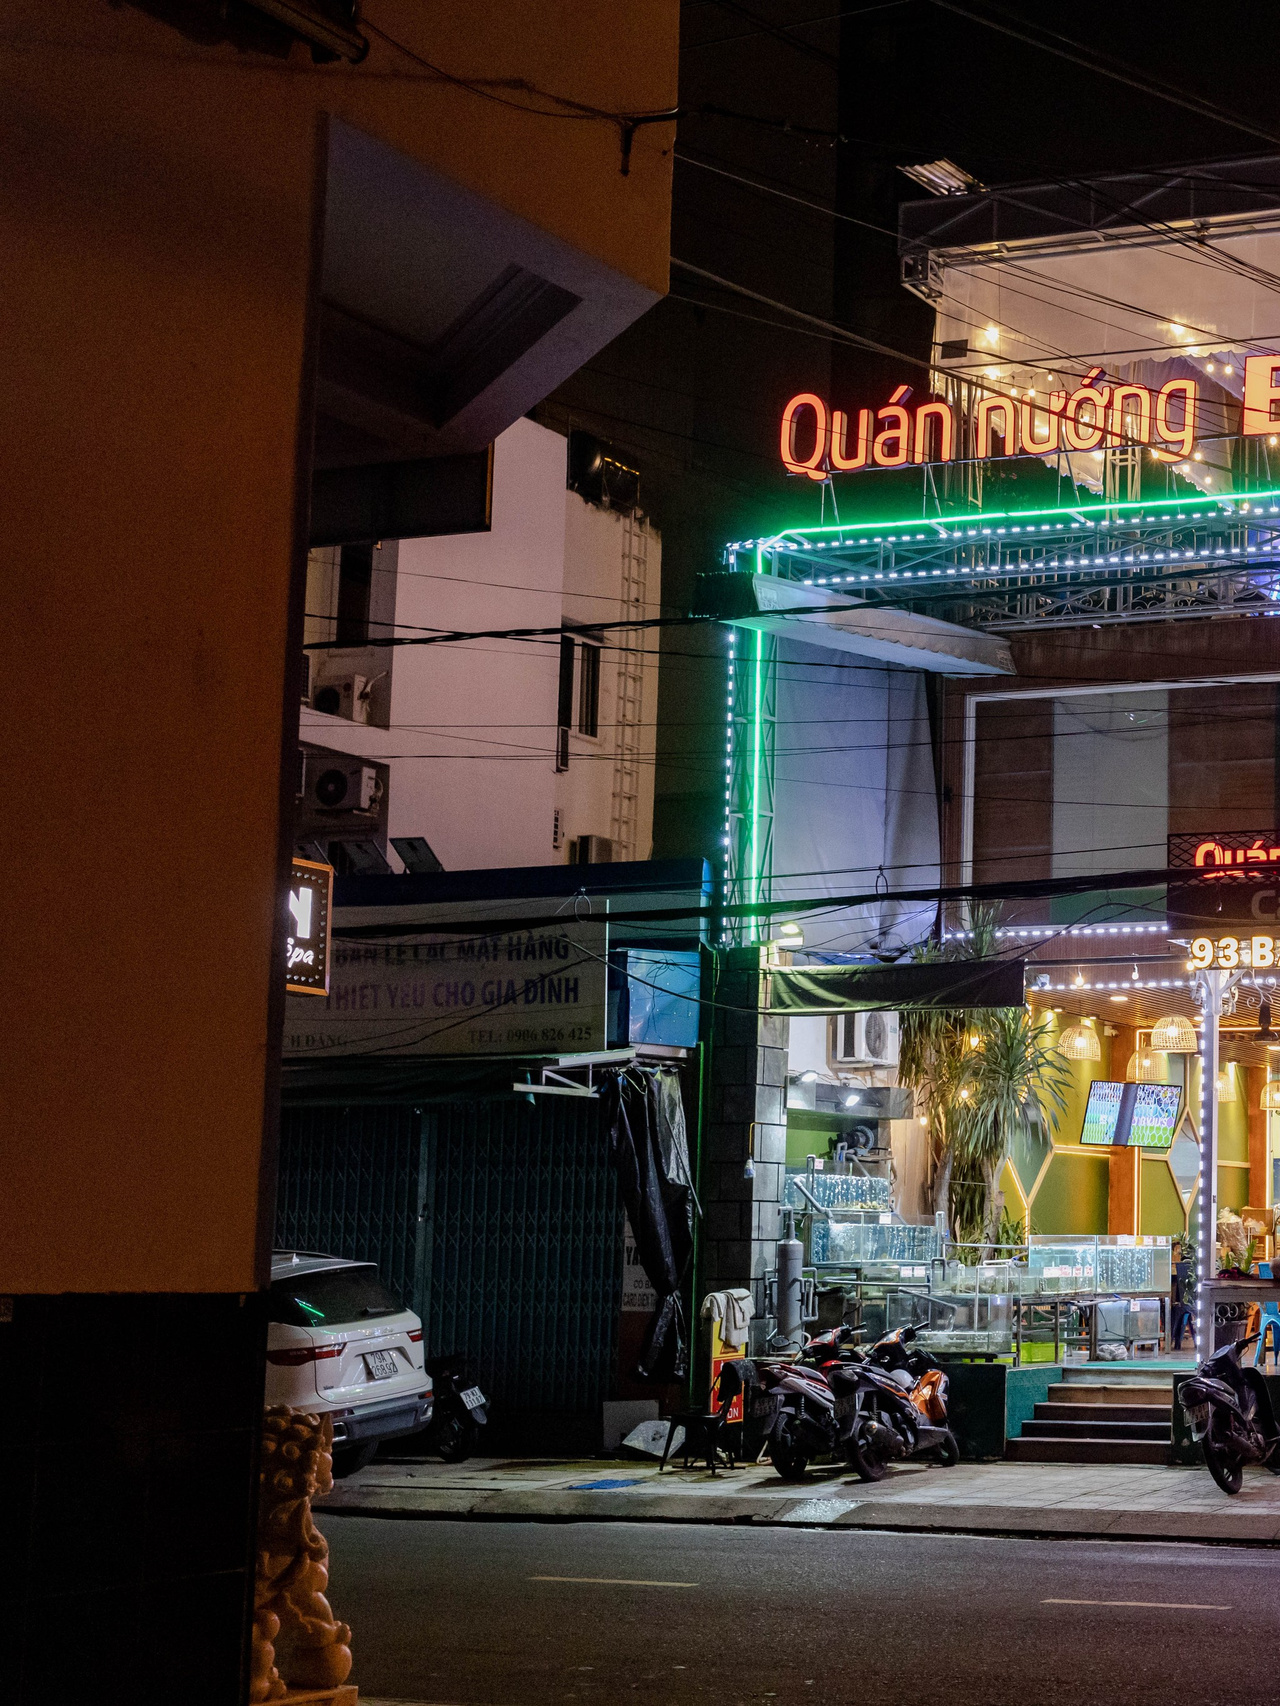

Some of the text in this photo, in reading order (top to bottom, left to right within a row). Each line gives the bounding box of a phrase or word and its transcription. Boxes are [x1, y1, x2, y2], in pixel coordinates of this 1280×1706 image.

[780, 385, 953, 481] Quán
[977, 367, 1199, 463] nướng
[1189, 937, 1240, 969] 93
[433, 981, 475, 1007] CHO
[481, 979, 517, 1006] GIA
[523, 973, 579, 1005] ĐÌNH
[541, 1027, 565, 1041] 826
[568, 1026, 592, 1041] 425
[370, 1350, 387, 1365] 79A
